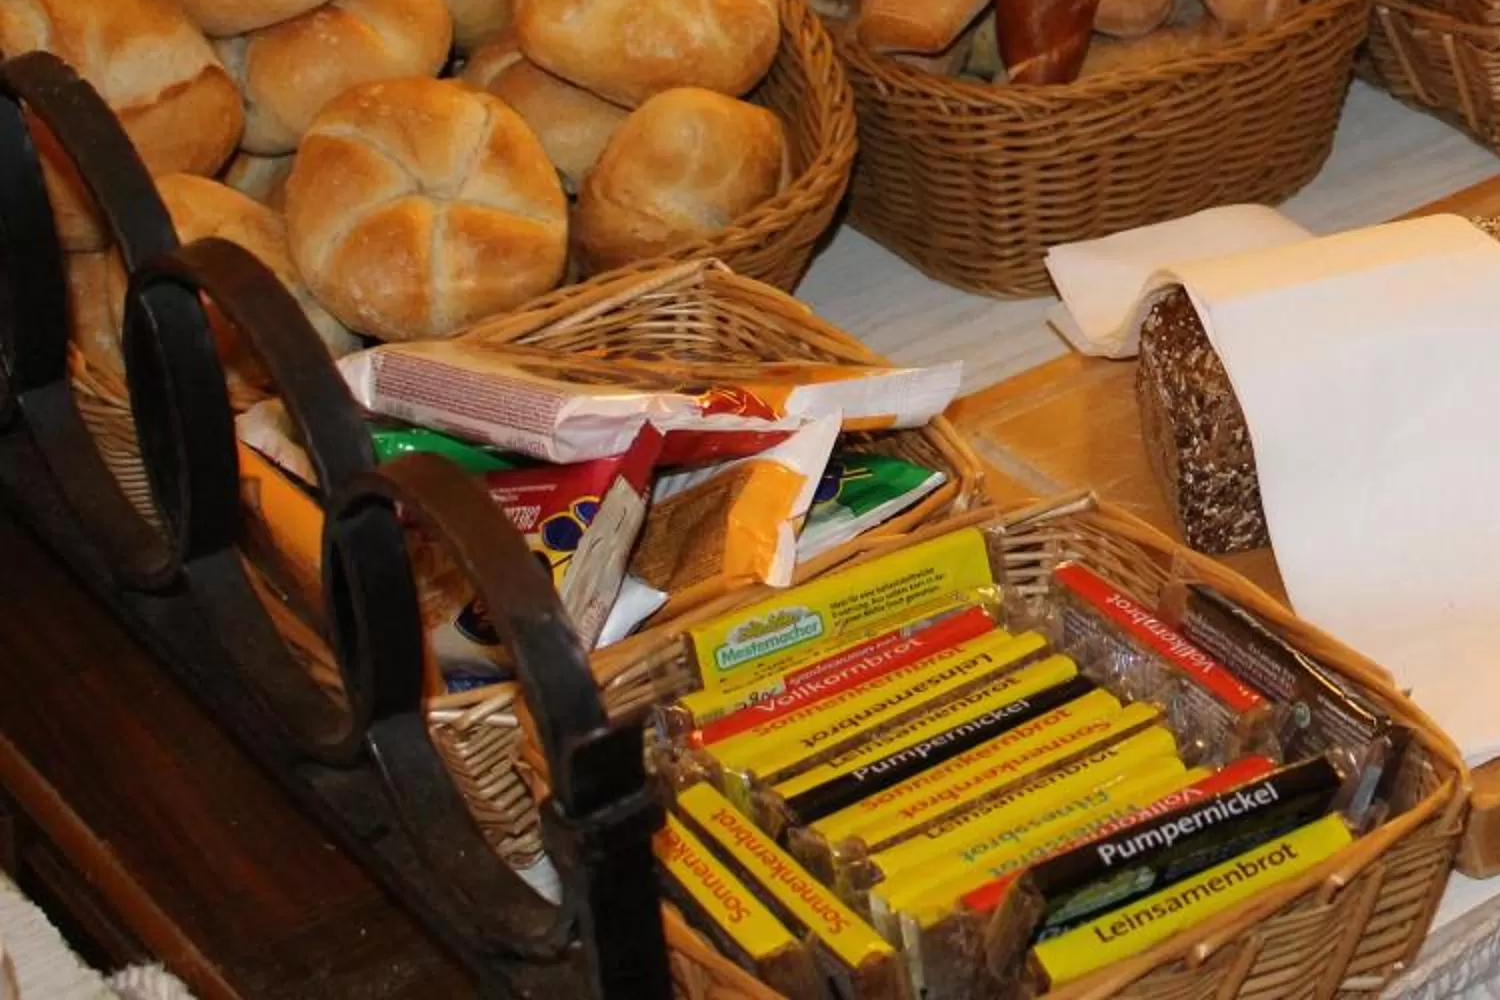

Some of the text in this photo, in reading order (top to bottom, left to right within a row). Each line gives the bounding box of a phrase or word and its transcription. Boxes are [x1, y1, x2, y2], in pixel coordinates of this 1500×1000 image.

[720, 616, 820, 665] Mestemacher
[755, 637, 928, 713] Vollkornbrot
[1104, 593, 1216, 676] Vollkornbrot
[802, 651, 993, 749] Leinsamenbrot
[829, 676, 1022, 769] Leinsamenbrot
[852, 698, 1032, 781] Pumpernickel
[861, 708, 1072, 812] Sonnenkernbrot
[899, 719, 1114, 820] Sonnenkernbrot
[924, 746, 1121, 840] Leinsamenbrot
[1097, 782, 1279, 865] Pumpernickel
[711, 808, 850, 934] Sonnenkernbrot
[1094, 843, 1298, 944] Leinsamenbrot
